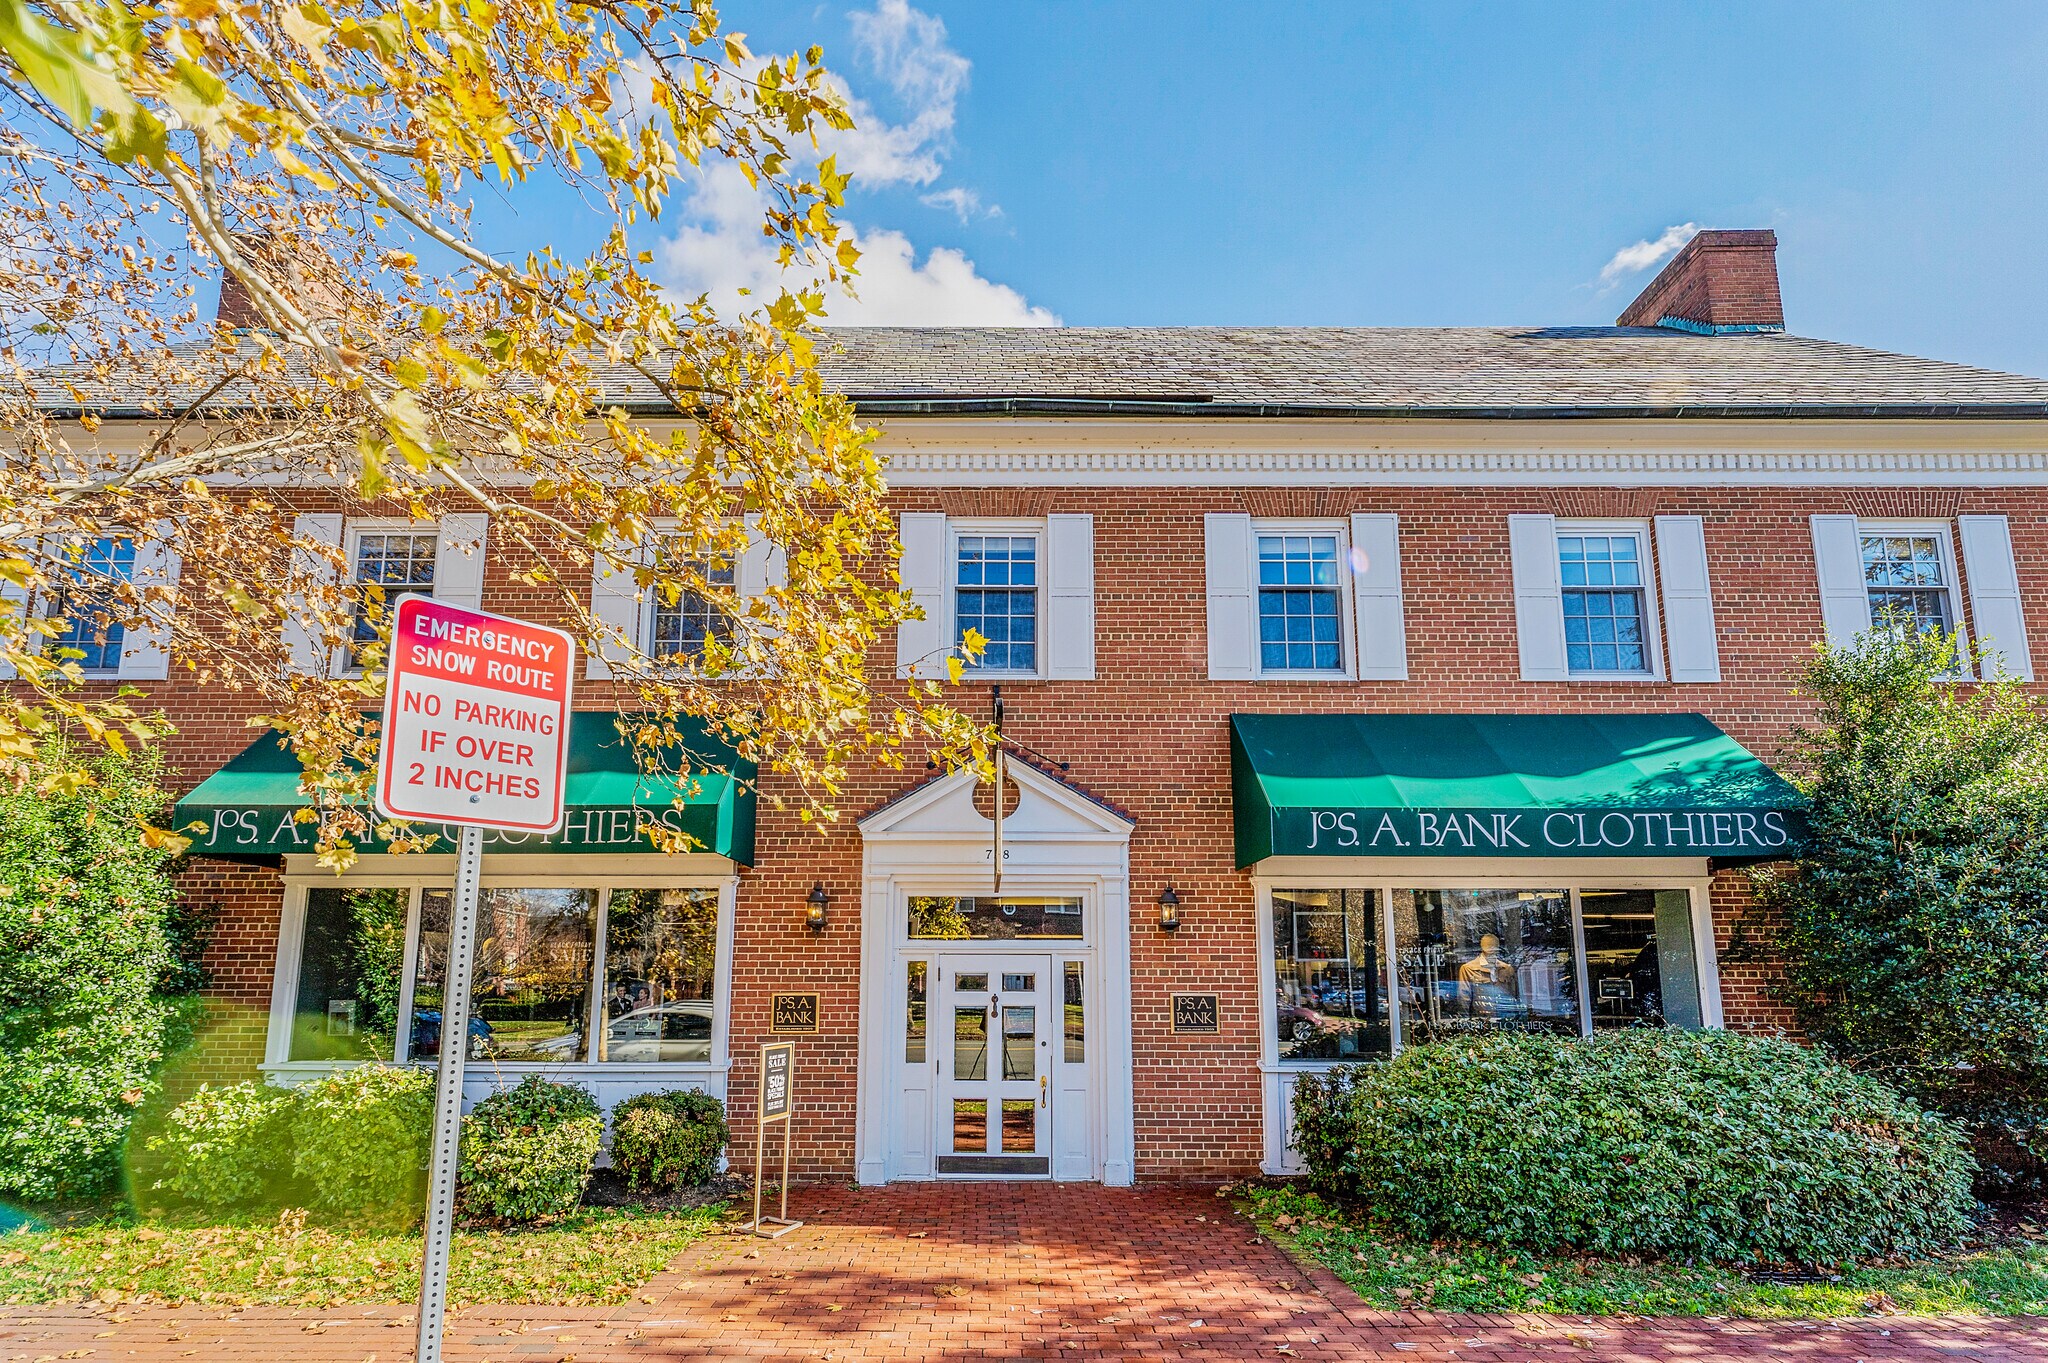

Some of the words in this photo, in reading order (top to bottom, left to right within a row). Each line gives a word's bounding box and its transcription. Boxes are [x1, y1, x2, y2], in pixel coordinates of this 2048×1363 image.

[414, 614, 555, 663] EMERGENCY
[411, 644, 477, 676] SNOW
[487, 660, 555, 692] ROUTE
[403, 690, 441, 716] NO
[454, 699, 554, 736] PARKING
[420, 729, 447, 753] IF
[456, 735, 534, 767] OVER
[408, 762, 424, 786] 2
[434, 765, 540, 799] INCHES
[267, 809, 309, 844] A.
[1369, 812, 1411, 847] A.
[1418, 813, 1531, 848] BANK
[1543, 812, 1787, 847] CLOTHIERS
[985, 849, 1010, 860] 78
[1402, 954, 1446, 967] SALE
[797, 996, 812, 1009] A.
[1197, 997, 1212, 1010] A.
[775, 1011, 814, 1024] BANK
[1176, 1011, 1215, 1024] BANK
[768, 1057, 787, 1069] SALE
